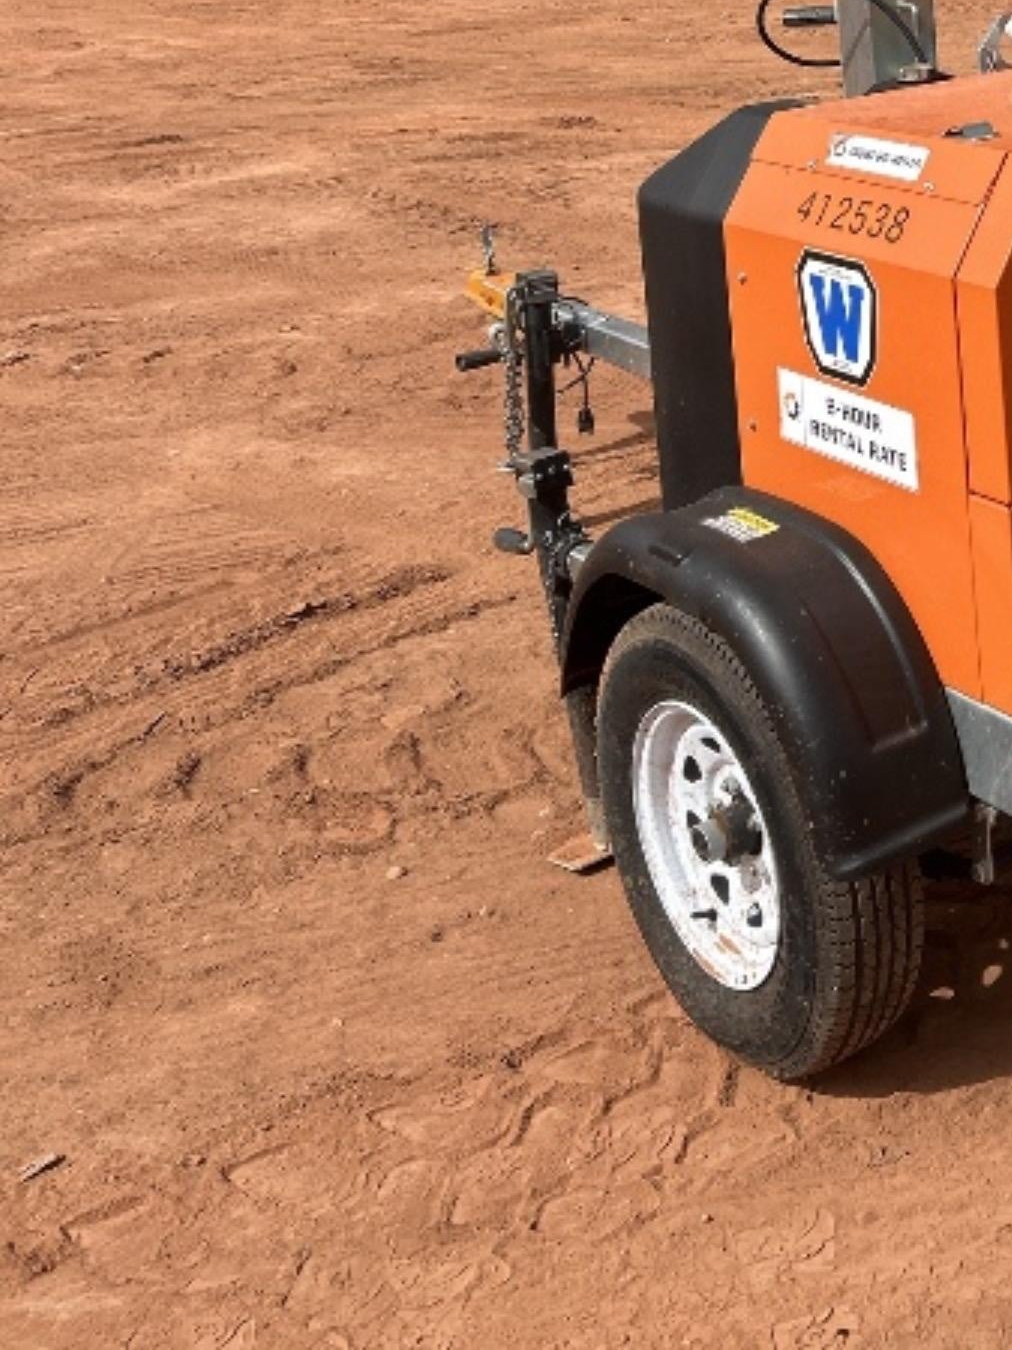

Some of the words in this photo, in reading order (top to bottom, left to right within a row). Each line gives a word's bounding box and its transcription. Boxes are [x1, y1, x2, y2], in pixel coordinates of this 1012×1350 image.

[797, 191, 911, 243] 412538
[808, 272, 865, 363] W
[810, 418, 863, 454] RENTAL
[869, 439, 907, 471] RATE
